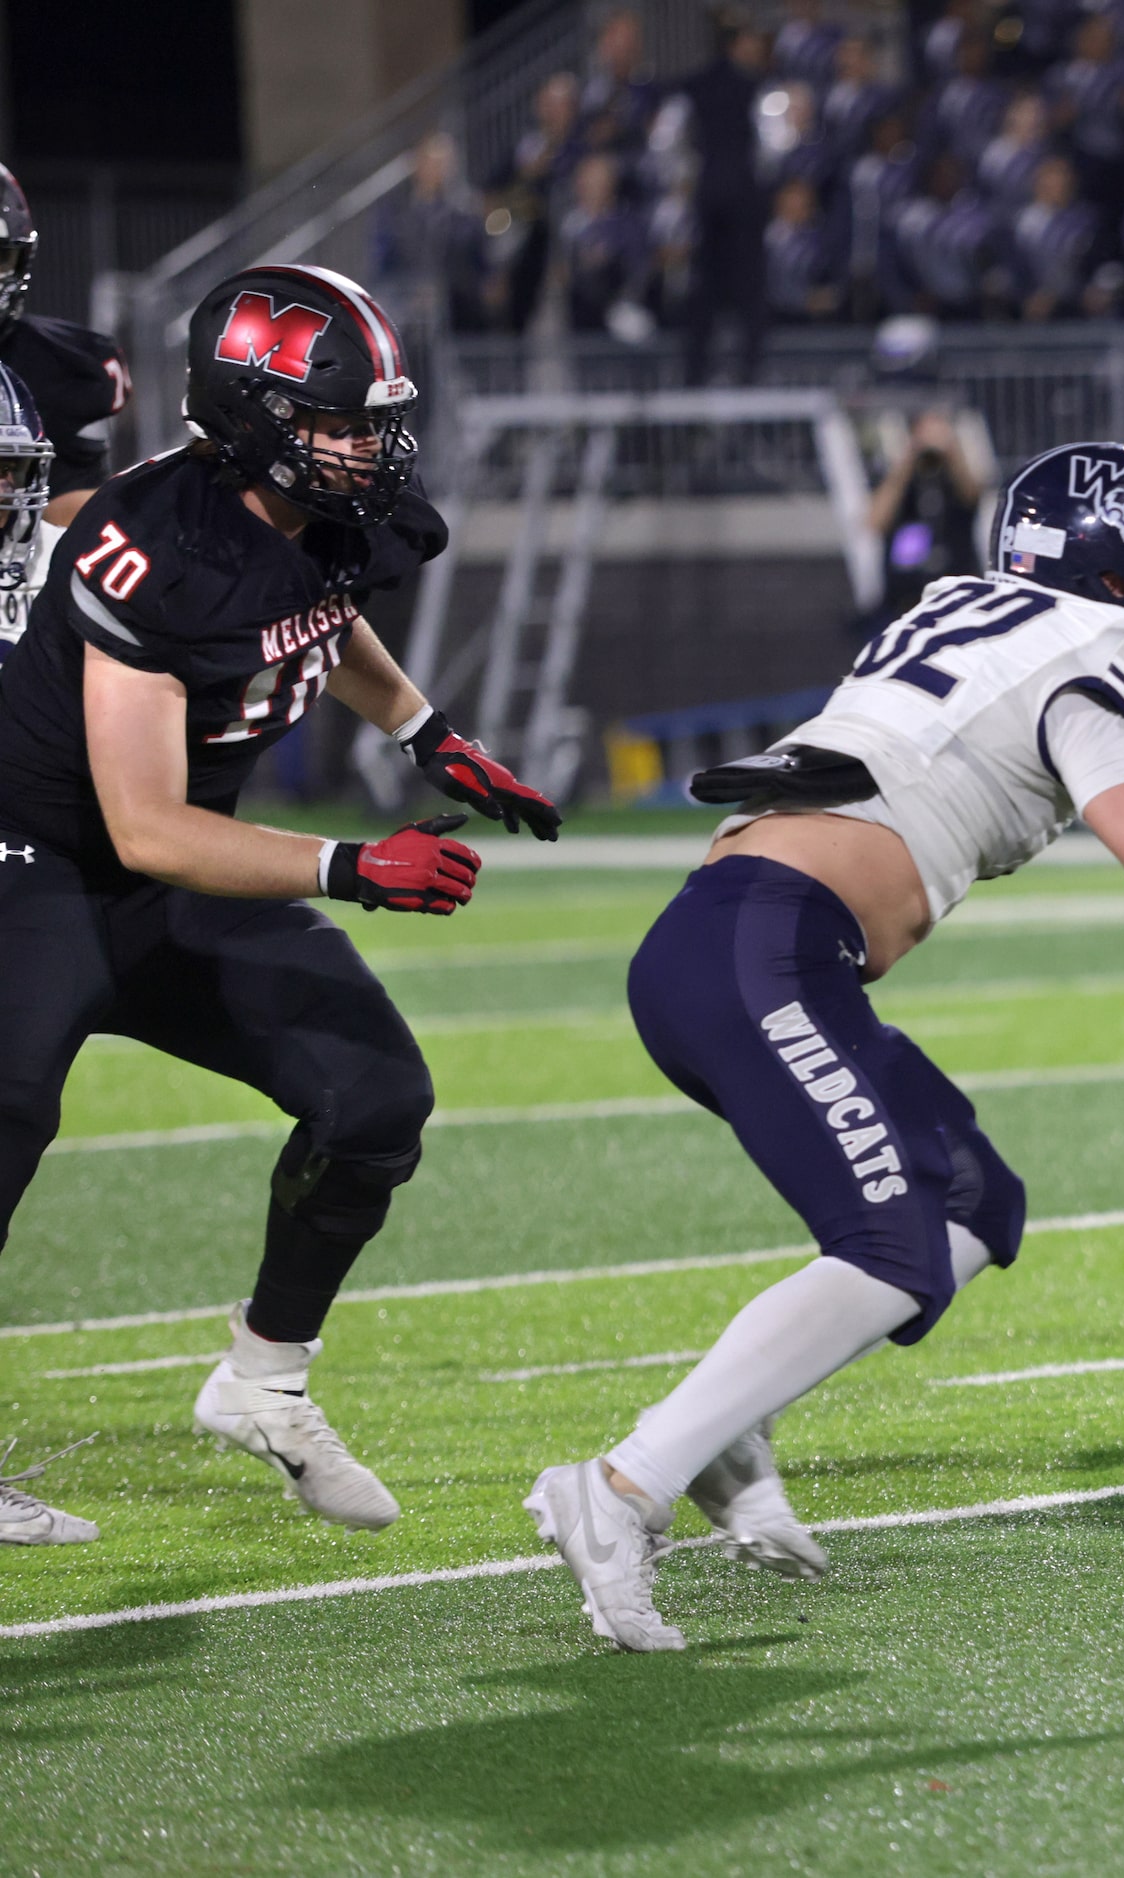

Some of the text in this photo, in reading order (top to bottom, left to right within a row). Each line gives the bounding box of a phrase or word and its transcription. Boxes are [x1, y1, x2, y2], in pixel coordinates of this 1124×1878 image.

[215, 291, 333, 383] M
[75, 520, 151, 602] 70
[259, 591, 359, 664] MELISSA
[761, 1001, 908, 1203] WILDCATS
